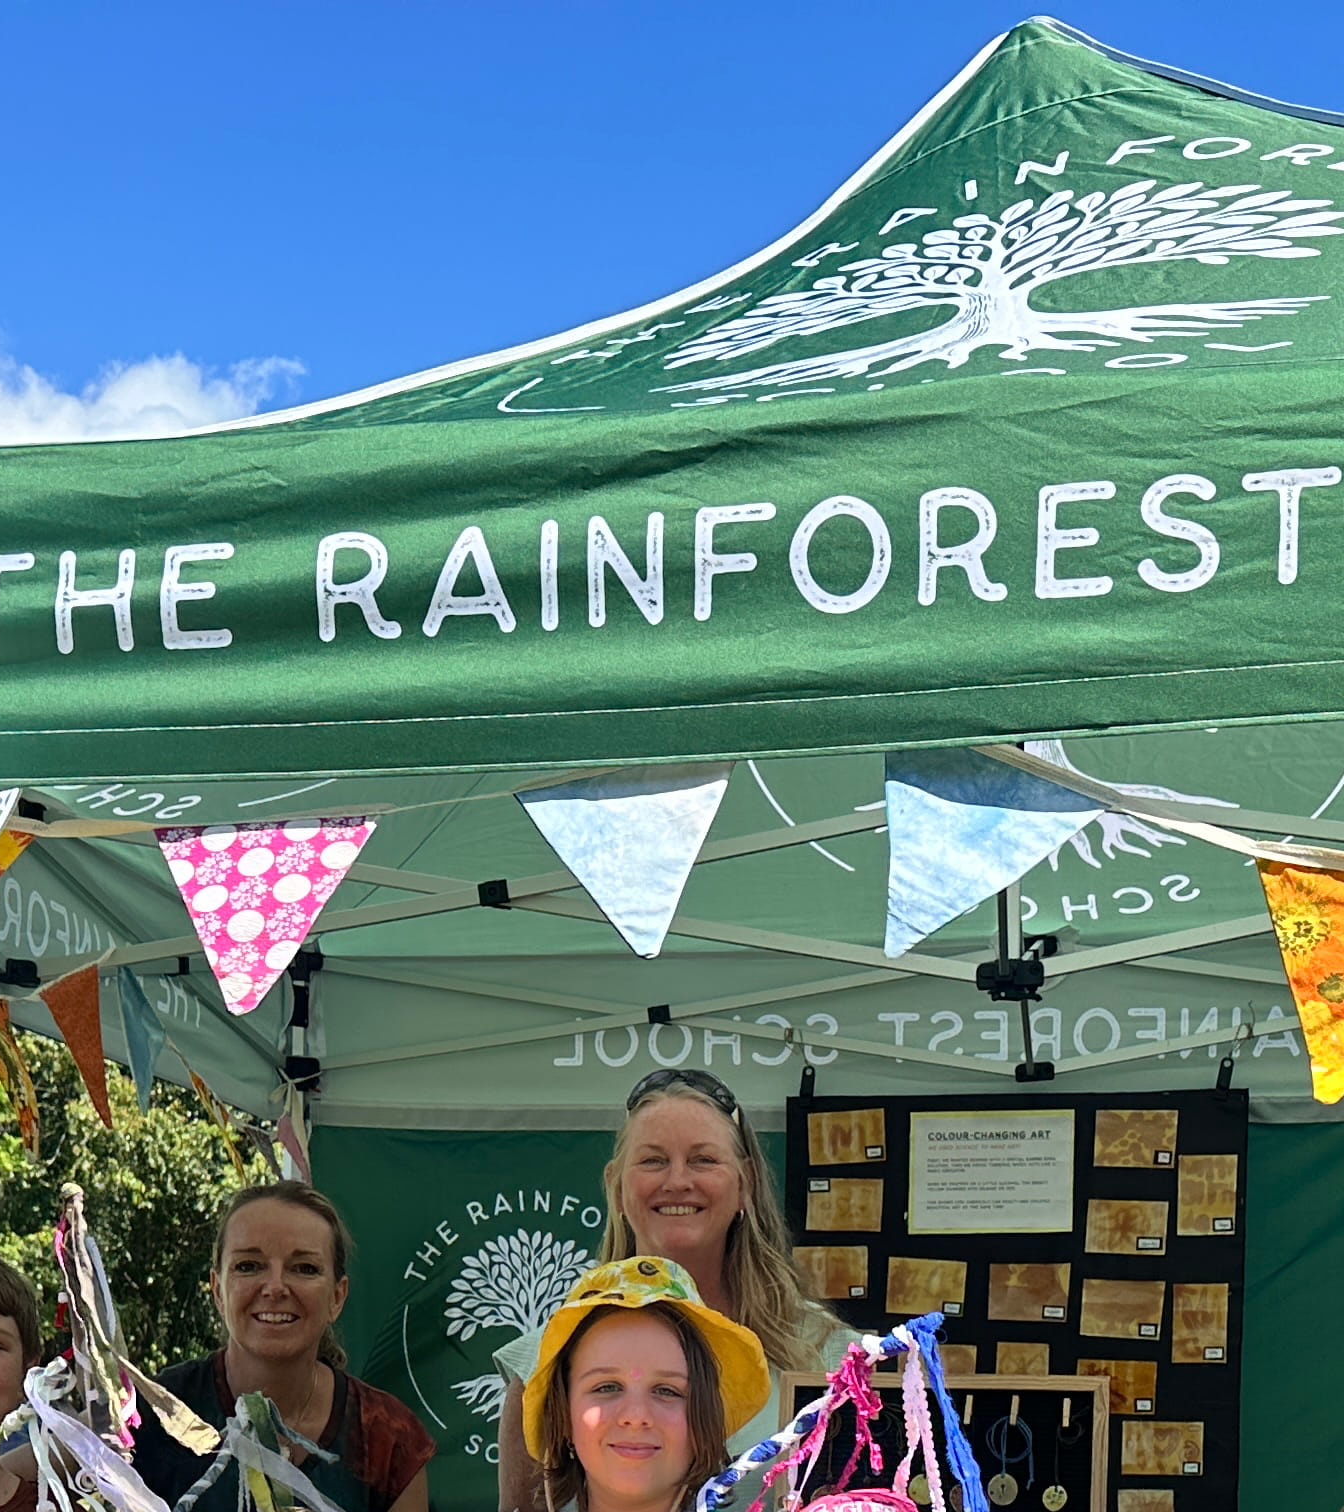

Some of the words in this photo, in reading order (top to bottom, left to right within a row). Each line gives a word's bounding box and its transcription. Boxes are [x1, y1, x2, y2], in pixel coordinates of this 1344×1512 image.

[316, 465, 1344, 642] RAINFOREST
[927, 1130, 1027, 1142] COLOUR-CHANGING
[1030, 1129, 1052, 1141] ART
[403, 1219, 460, 1283] THE
